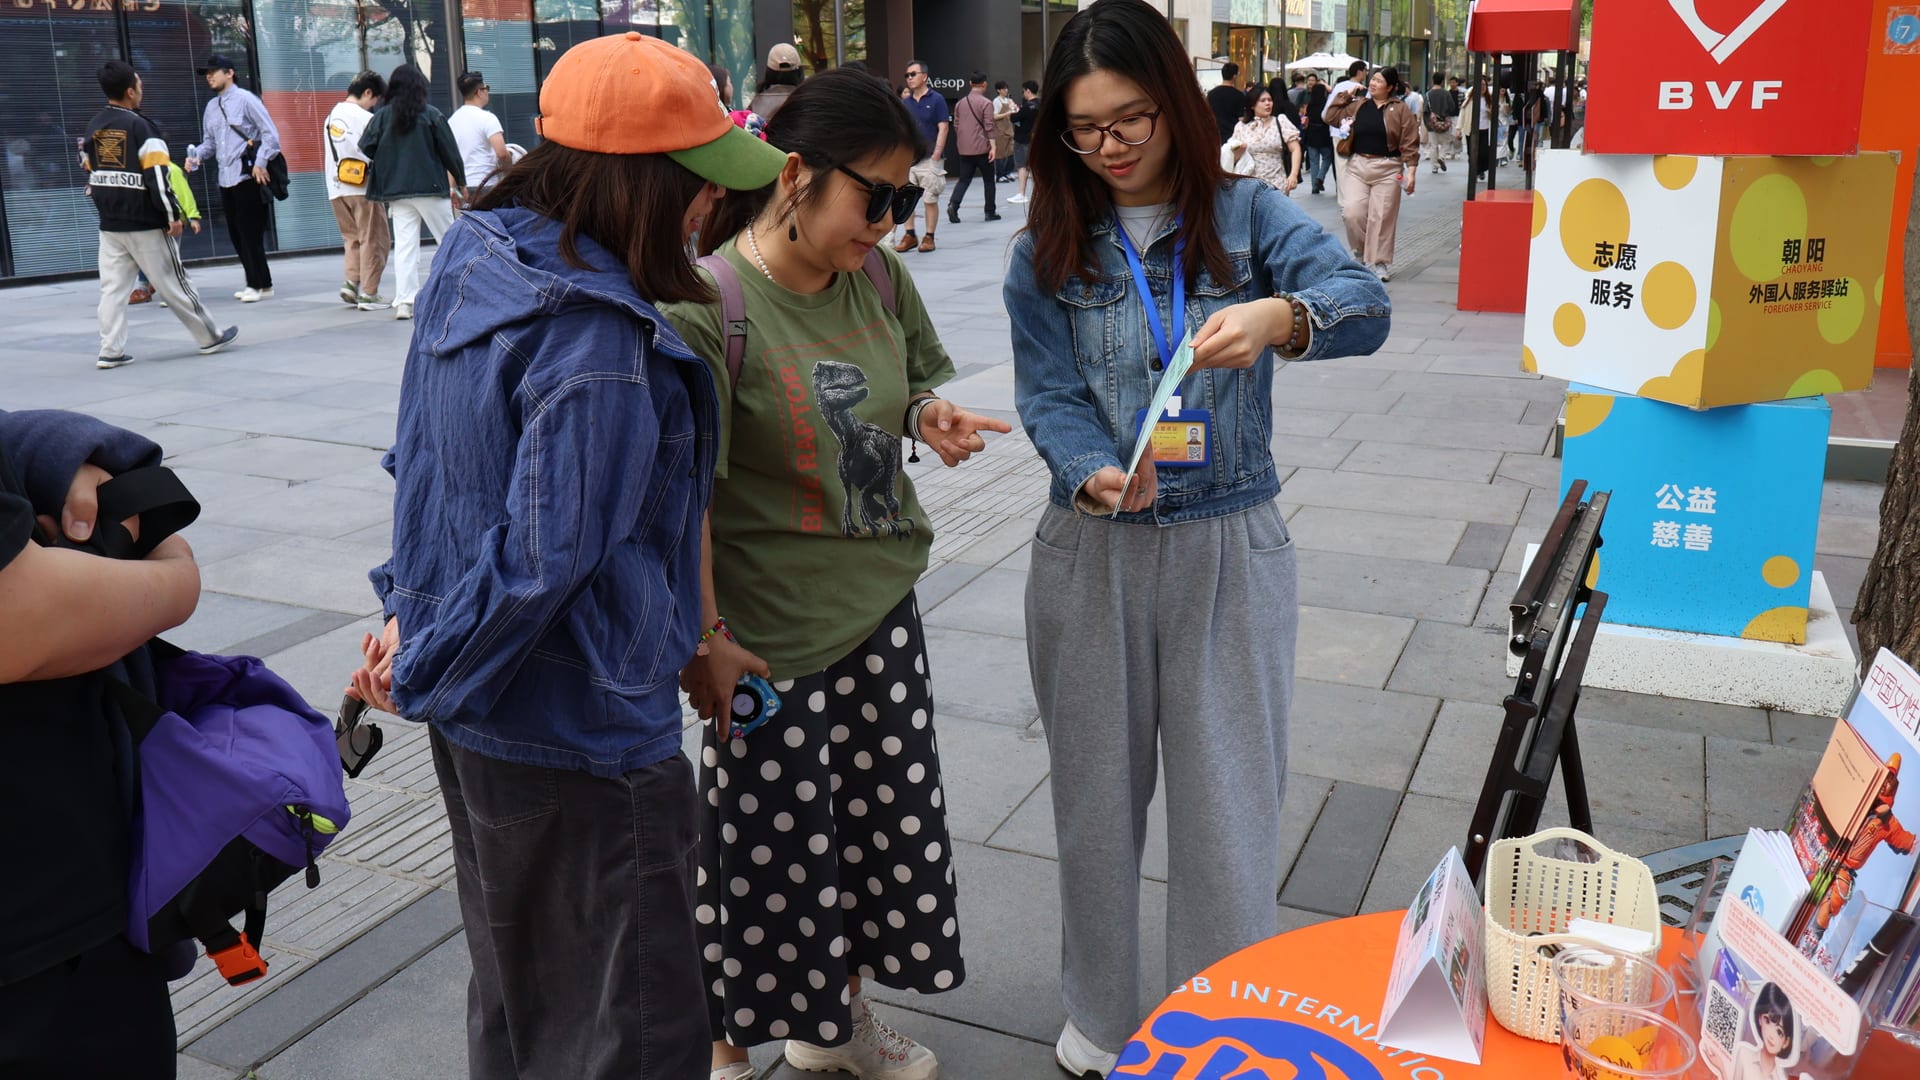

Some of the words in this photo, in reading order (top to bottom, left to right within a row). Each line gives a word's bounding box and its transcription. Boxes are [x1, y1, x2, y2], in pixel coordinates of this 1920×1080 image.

[1900, 25, 1911, 40] 7
[1658, 80, 1783, 110] BVF
[1593, 241, 1638, 271] 志愿
[1781, 238, 1826, 264] 朝阳
[1781, 263, 1824, 275] CHAOYANG
[1590, 278, 1634, 310] 服务
[1749, 278, 1849, 304] 外国人服务驿站
[1763, 303, 1803, 315] FOREIGNER
[1804, 300, 1833, 312] SERVICE
[779, 363, 818, 472] RAPTOR
[1655, 483, 1717, 514] 公益
[1650, 520, 1713, 551] 慈善
[1871, 663, 1920, 731] 中国女性
